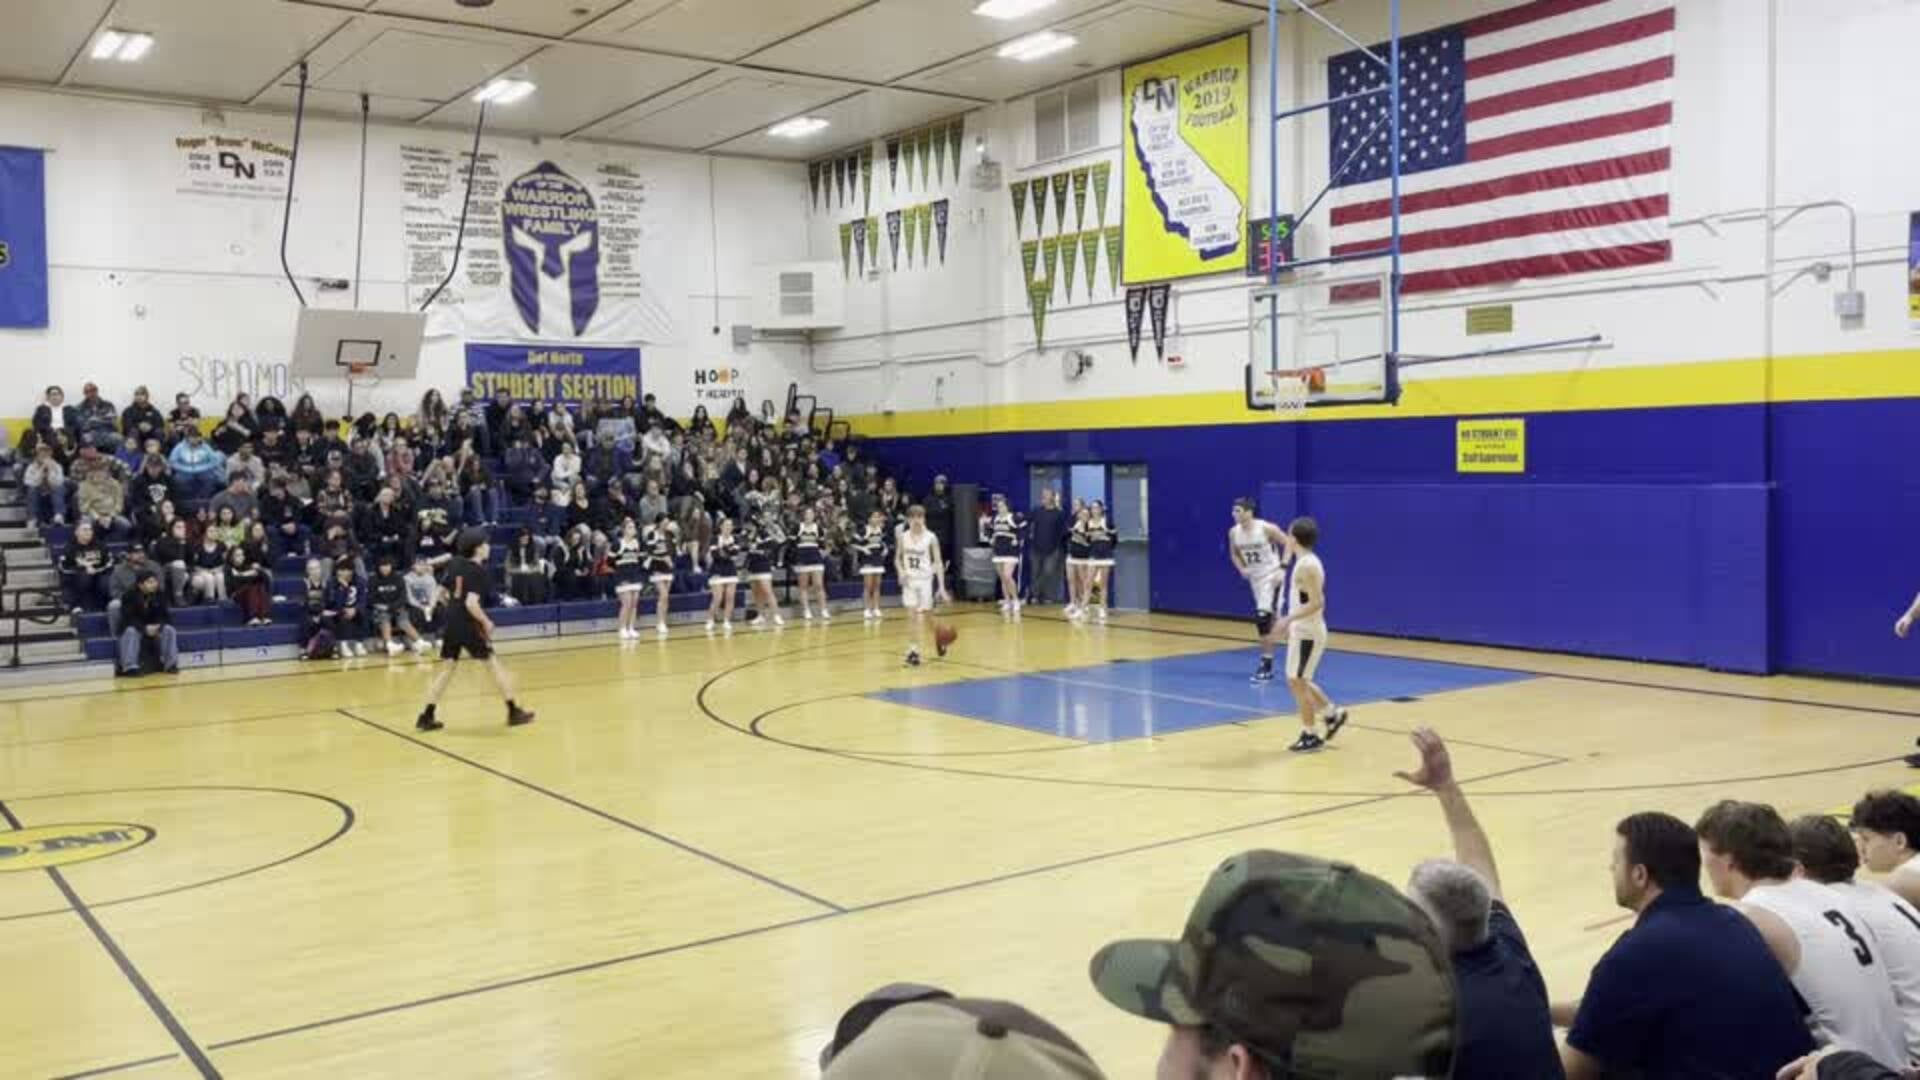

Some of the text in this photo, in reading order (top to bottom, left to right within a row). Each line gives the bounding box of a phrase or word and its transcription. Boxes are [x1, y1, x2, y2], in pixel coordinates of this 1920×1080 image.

[1193, 88, 1231, 110] 2019
[218, 152, 256, 179] DN
[511, 187, 588, 206] WARRIOR
[502, 202, 597, 221] WRESTLING
[522, 219, 581, 235] FAMILY
[471, 371, 638, 402] STUDENT SECTION
[1823, 909, 1873, 967] 3
